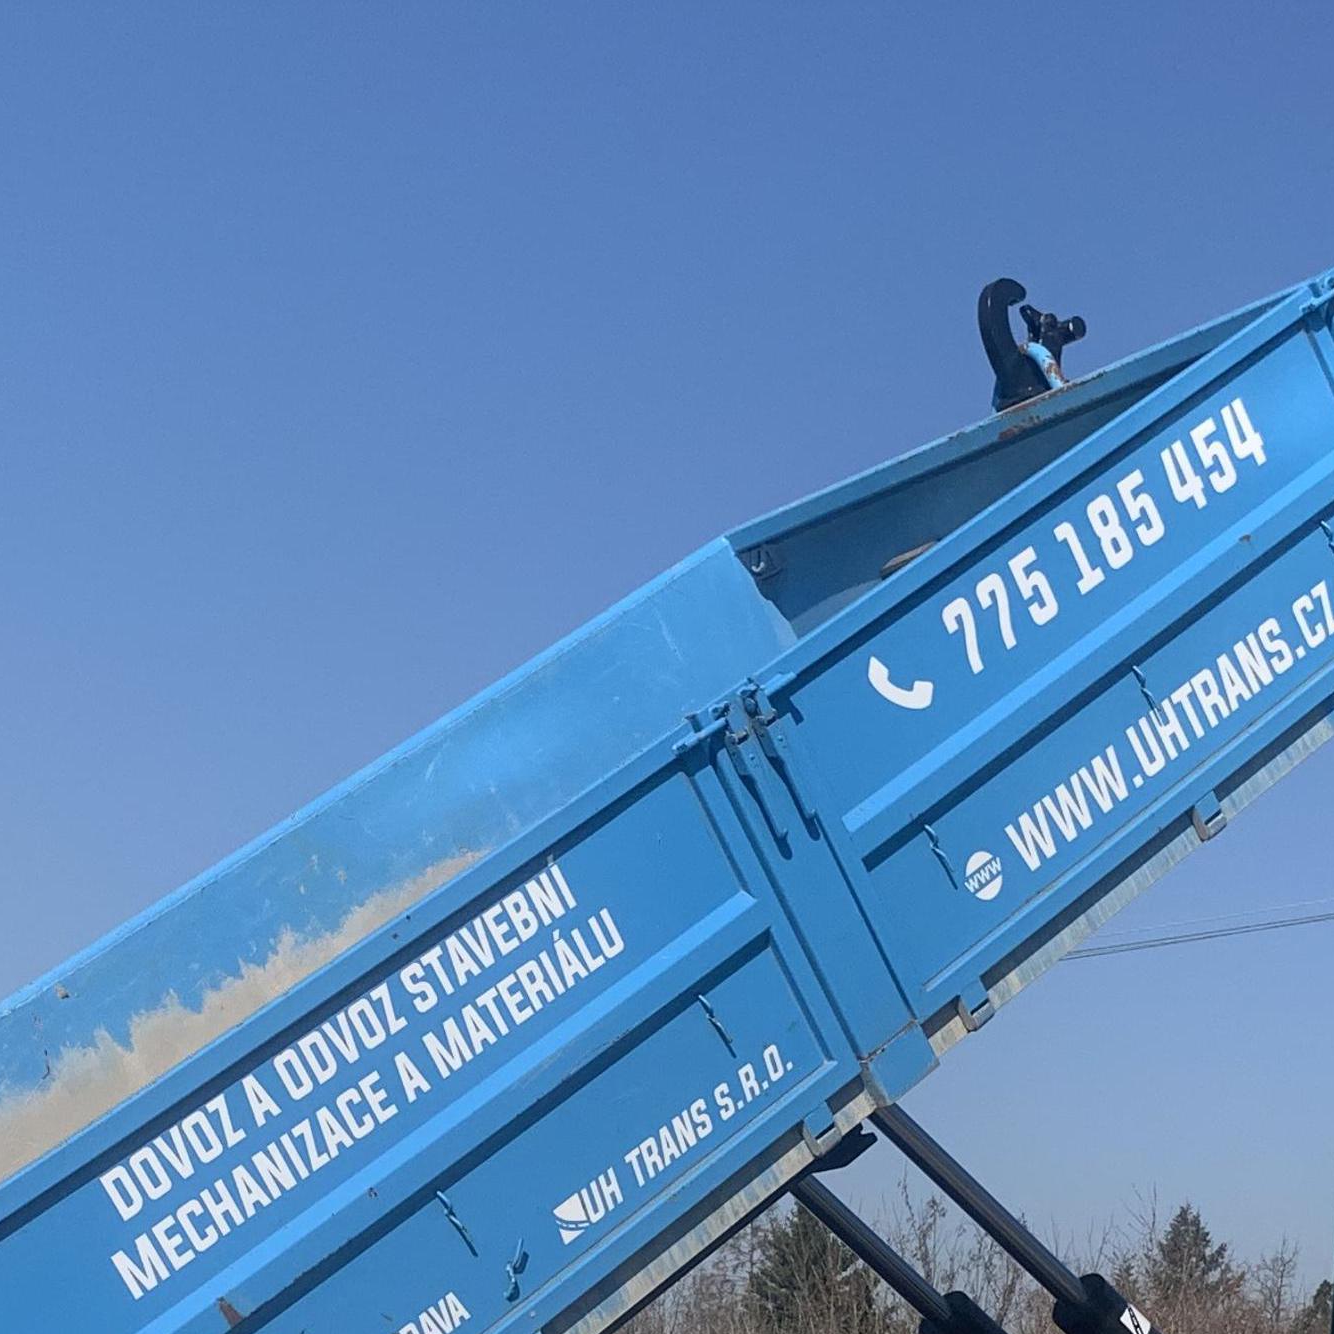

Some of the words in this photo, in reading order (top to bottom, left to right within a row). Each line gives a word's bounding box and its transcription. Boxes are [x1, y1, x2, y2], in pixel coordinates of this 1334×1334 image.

[941, 546, 1058, 674] 775
[1053, 469, 1165, 595] 185
[1161, 397, 1267, 509] 454
[99, 1094, 247, 1221] DOVOZ
[241, 1074, 282, 1128] A
[273, 982, 408, 1101] ODVOZ
[399, 859, 577, 1013] STAVEBNÍ
[110, 1070, 398, 1300] MECHANIZACE
[394, 1051, 431, 1103] A
[422, 908, 625, 1079] MATERIÁLU
[580, 1167, 624, 1223] UH
[624, 1098, 713, 1187] TRANS
[714, 1044, 794, 1121] S.R.O.
